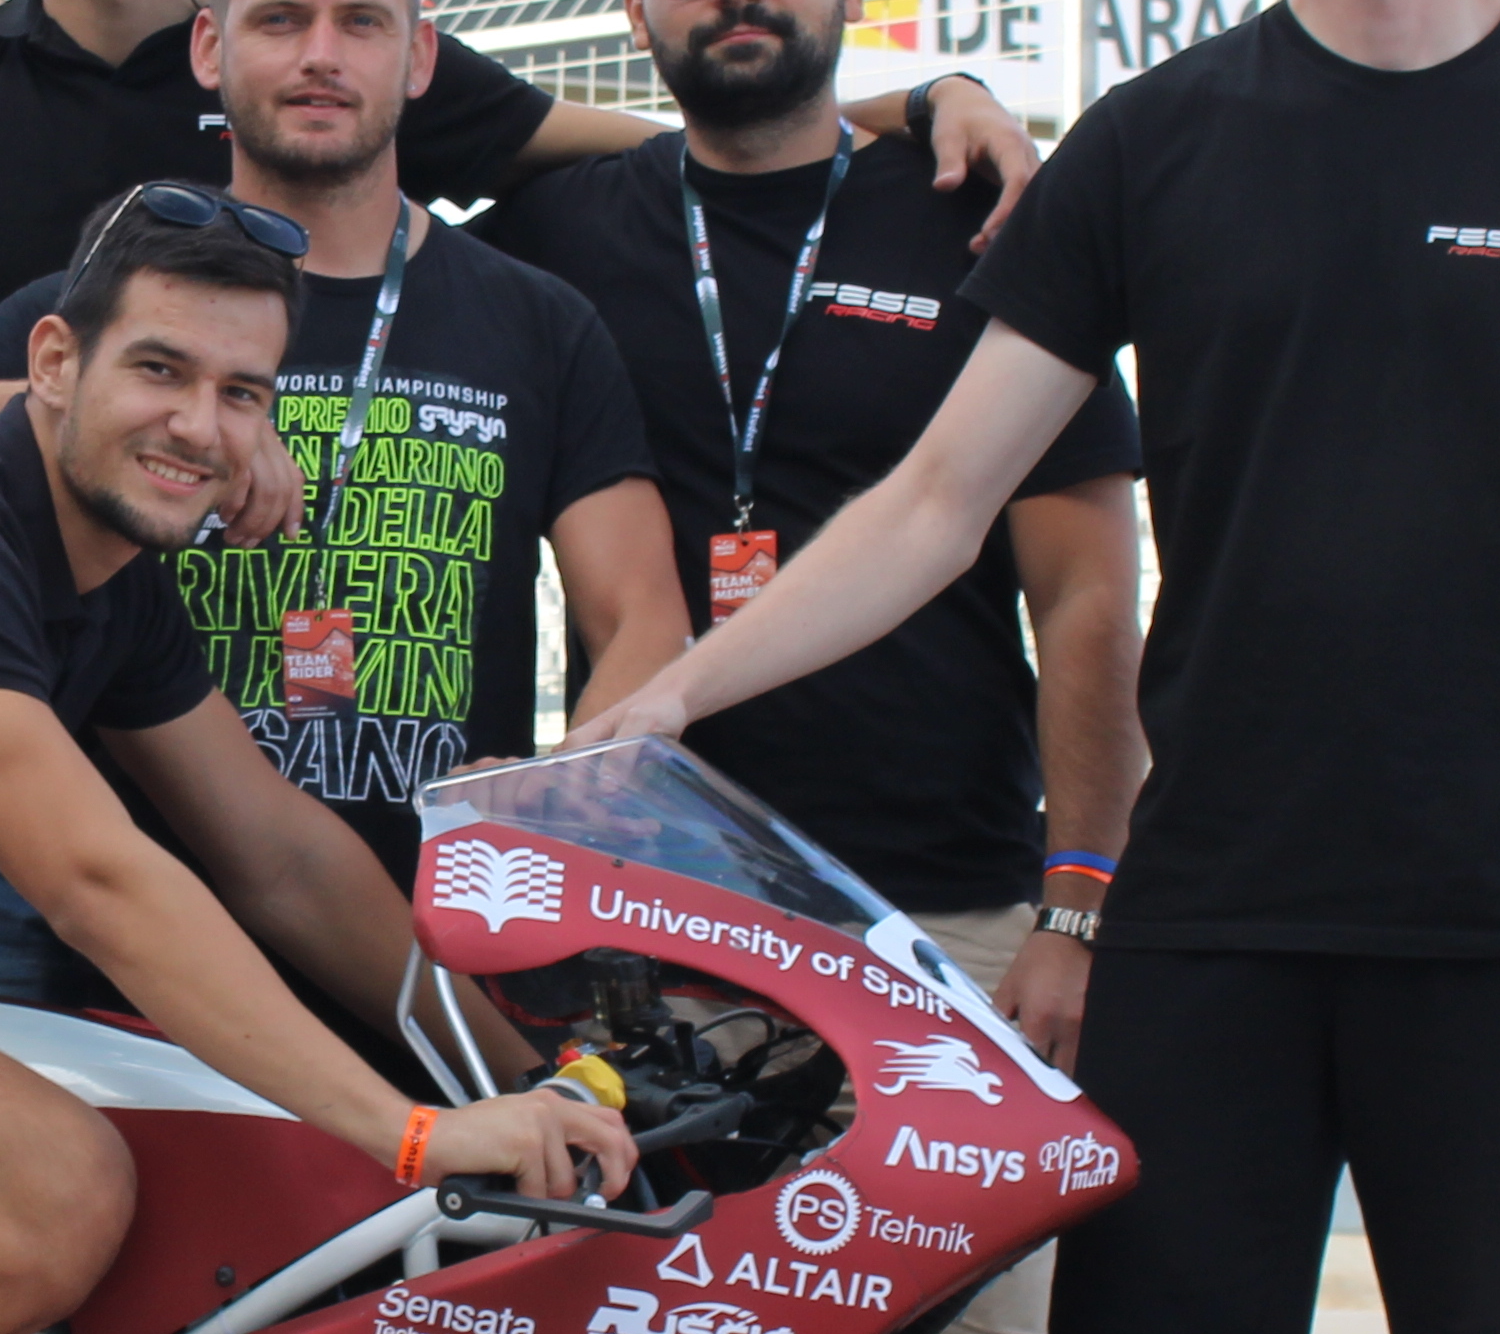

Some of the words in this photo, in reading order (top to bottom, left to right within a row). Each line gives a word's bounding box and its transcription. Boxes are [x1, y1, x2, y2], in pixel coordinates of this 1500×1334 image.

[806, 282, 942, 320] FESB
[353, 375, 508, 411] AMPIONSHIP
[327, 487, 493, 562] DELLA
[712, 575, 754, 588] TEAM
[714, 587, 760, 601] MEMB
[285, 654, 330, 666] TEAM
[289, 666, 335, 679] RIDER
[589, 884, 804, 971] University
[811, 950, 856, 982] of
[862, 964, 953, 1023] Split
[884, 1125, 1027, 1190] Ansys
[790, 1193, 846, 1231] PS
[864, 1204, 975, 1256] Tehnik
[724, 1251, 893, 1312] ALTAIR
